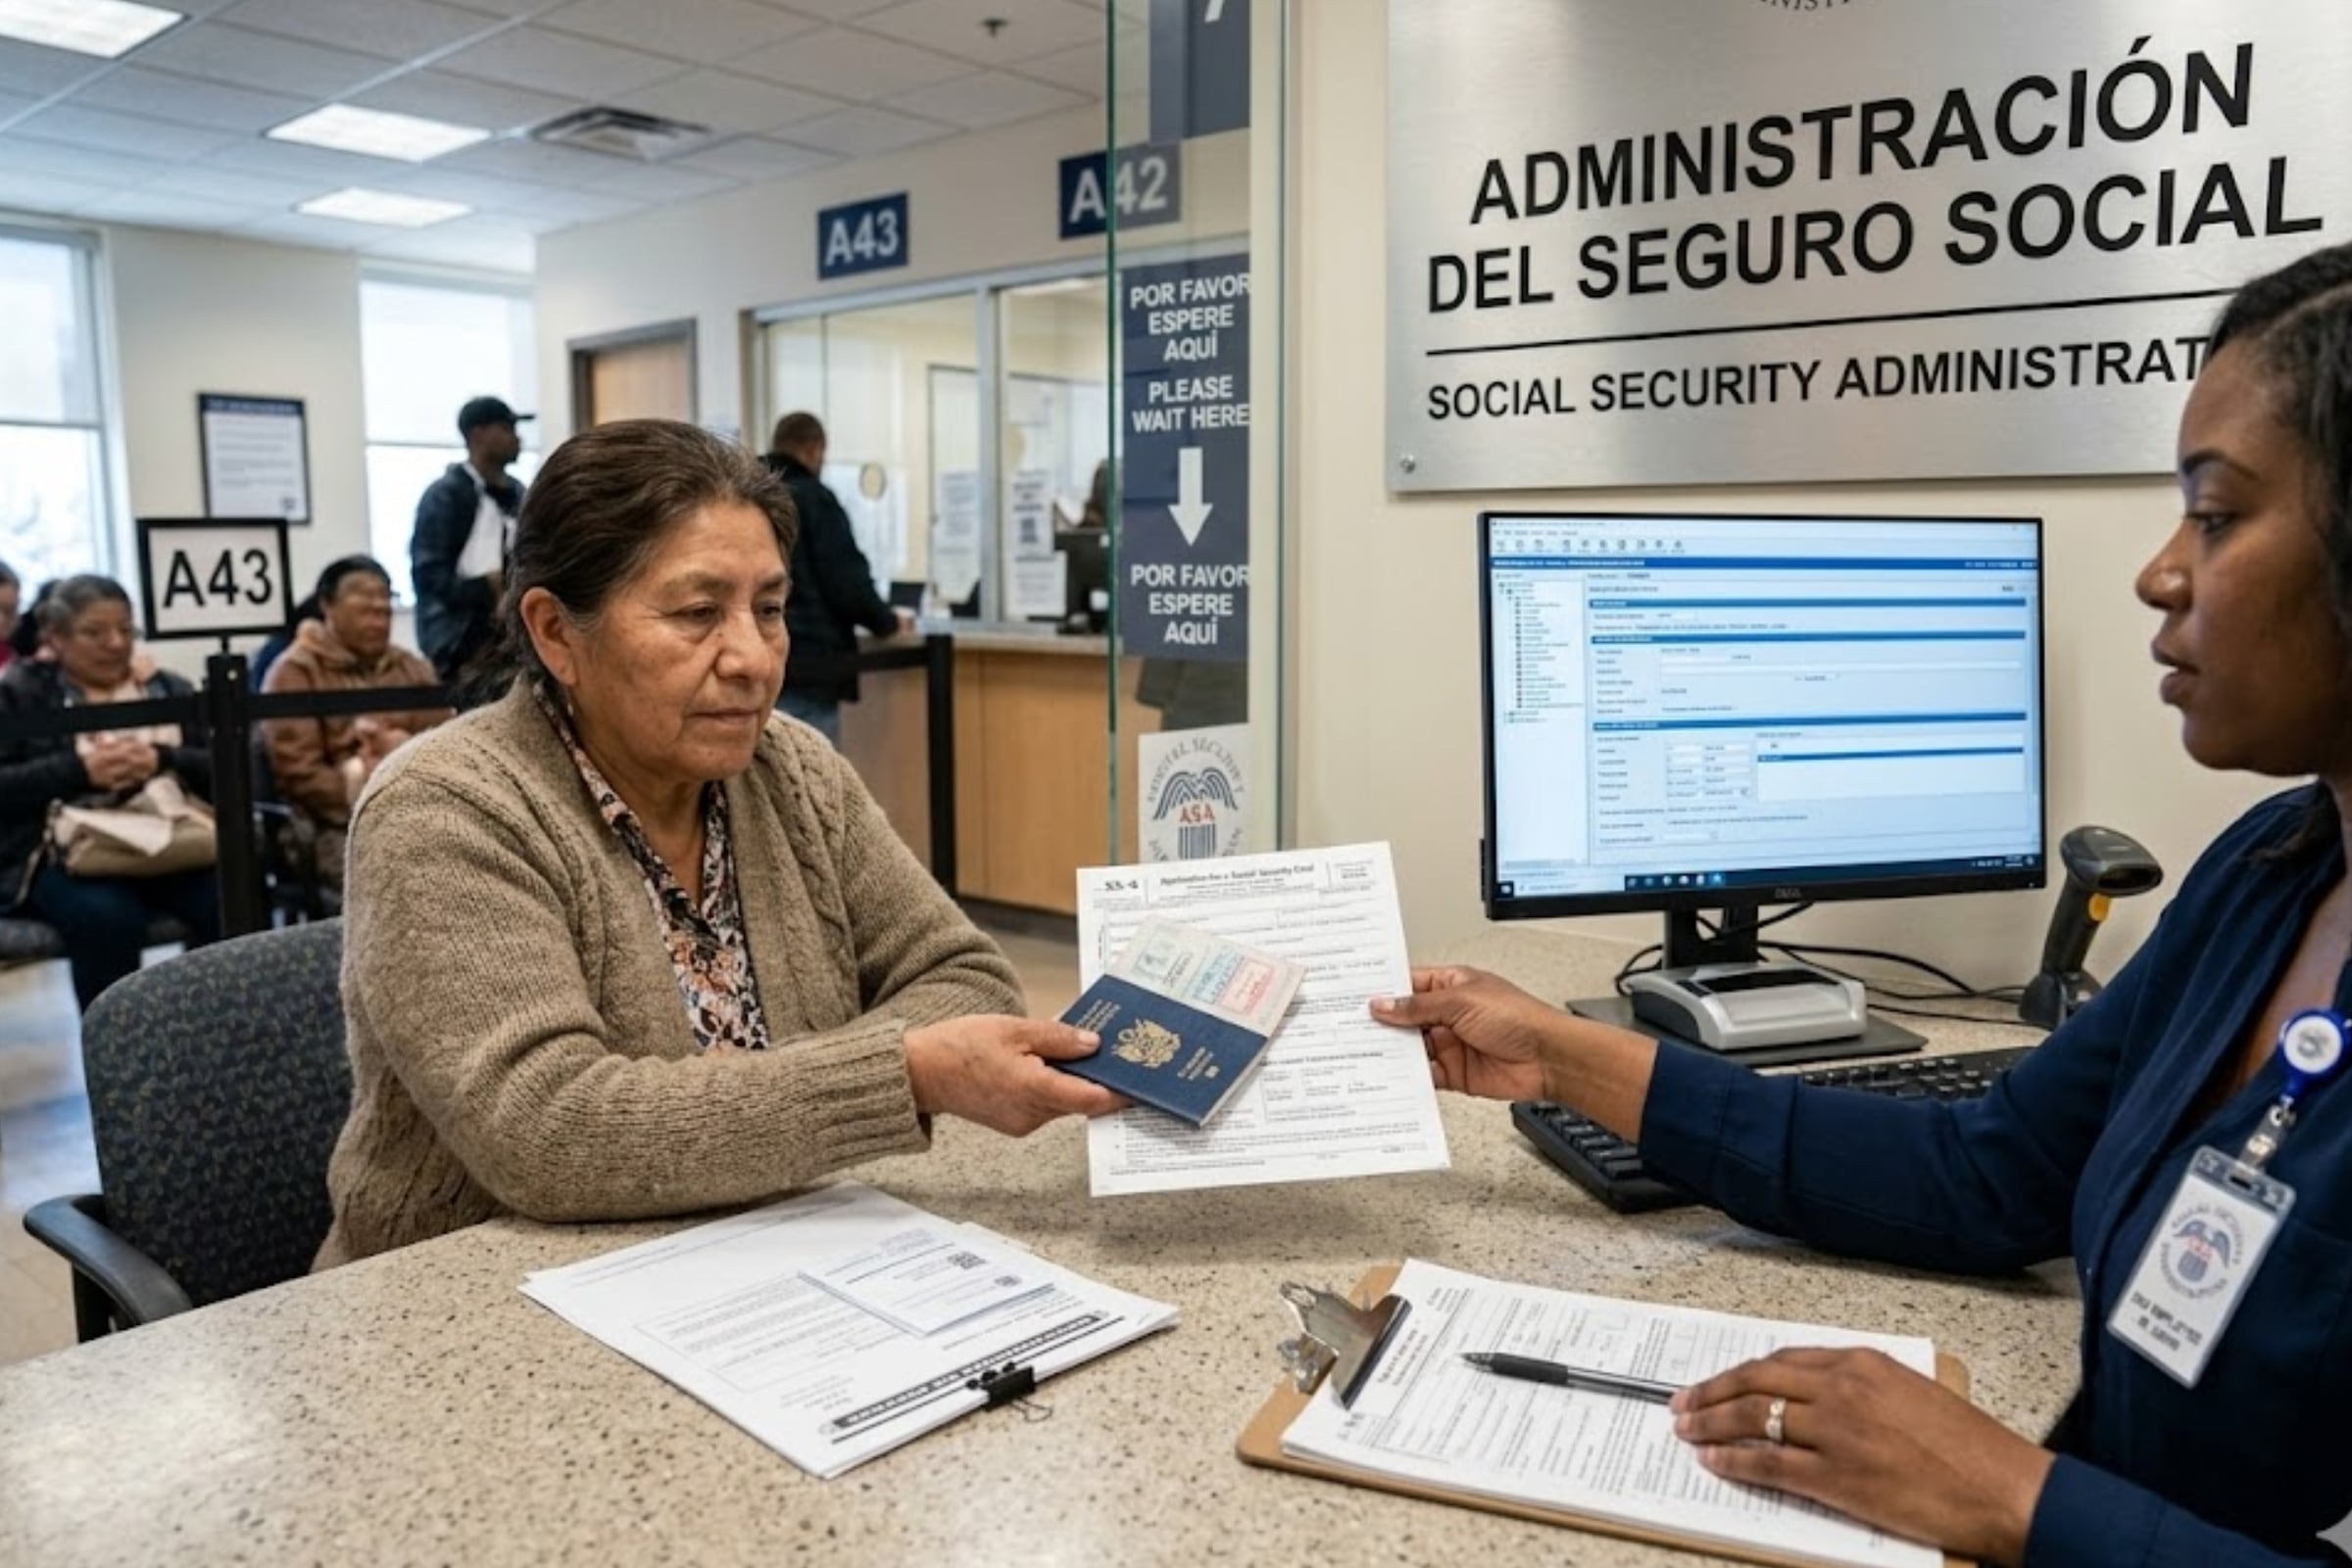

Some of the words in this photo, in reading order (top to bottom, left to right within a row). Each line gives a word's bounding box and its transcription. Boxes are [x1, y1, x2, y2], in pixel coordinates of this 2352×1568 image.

[1470, 35, 2253, 225] ADMINISTRACIÓN
[1068, 156, 1167, 222] A42
[824, 209, 900, 267] A43
[1429, 246, 1554, 314] DEL
[1577, 202, 1914, 300] SEGURO
[1945, 157, 2324, 266] SOCIAL
[1130, 282, 1176, 311] POR
[1148, 304, 1235, 335] ESPERE
[1149, 374, 1234, 405] PLEASE
[1428, 377, 1577, 420] SOCIAL
[1590, 361, 1822, 413] SECURITY
[1835, 335, 2212, 399] ADMINISTRAT
[1132, 407, 1187, 433] WAIT
[1191, 403, 1251, 430] HERE
[162, 547, 273, 610] A43
[1130, 564, 1176, 587] POR
[1149, 592, 1234, 616] ESPERE
